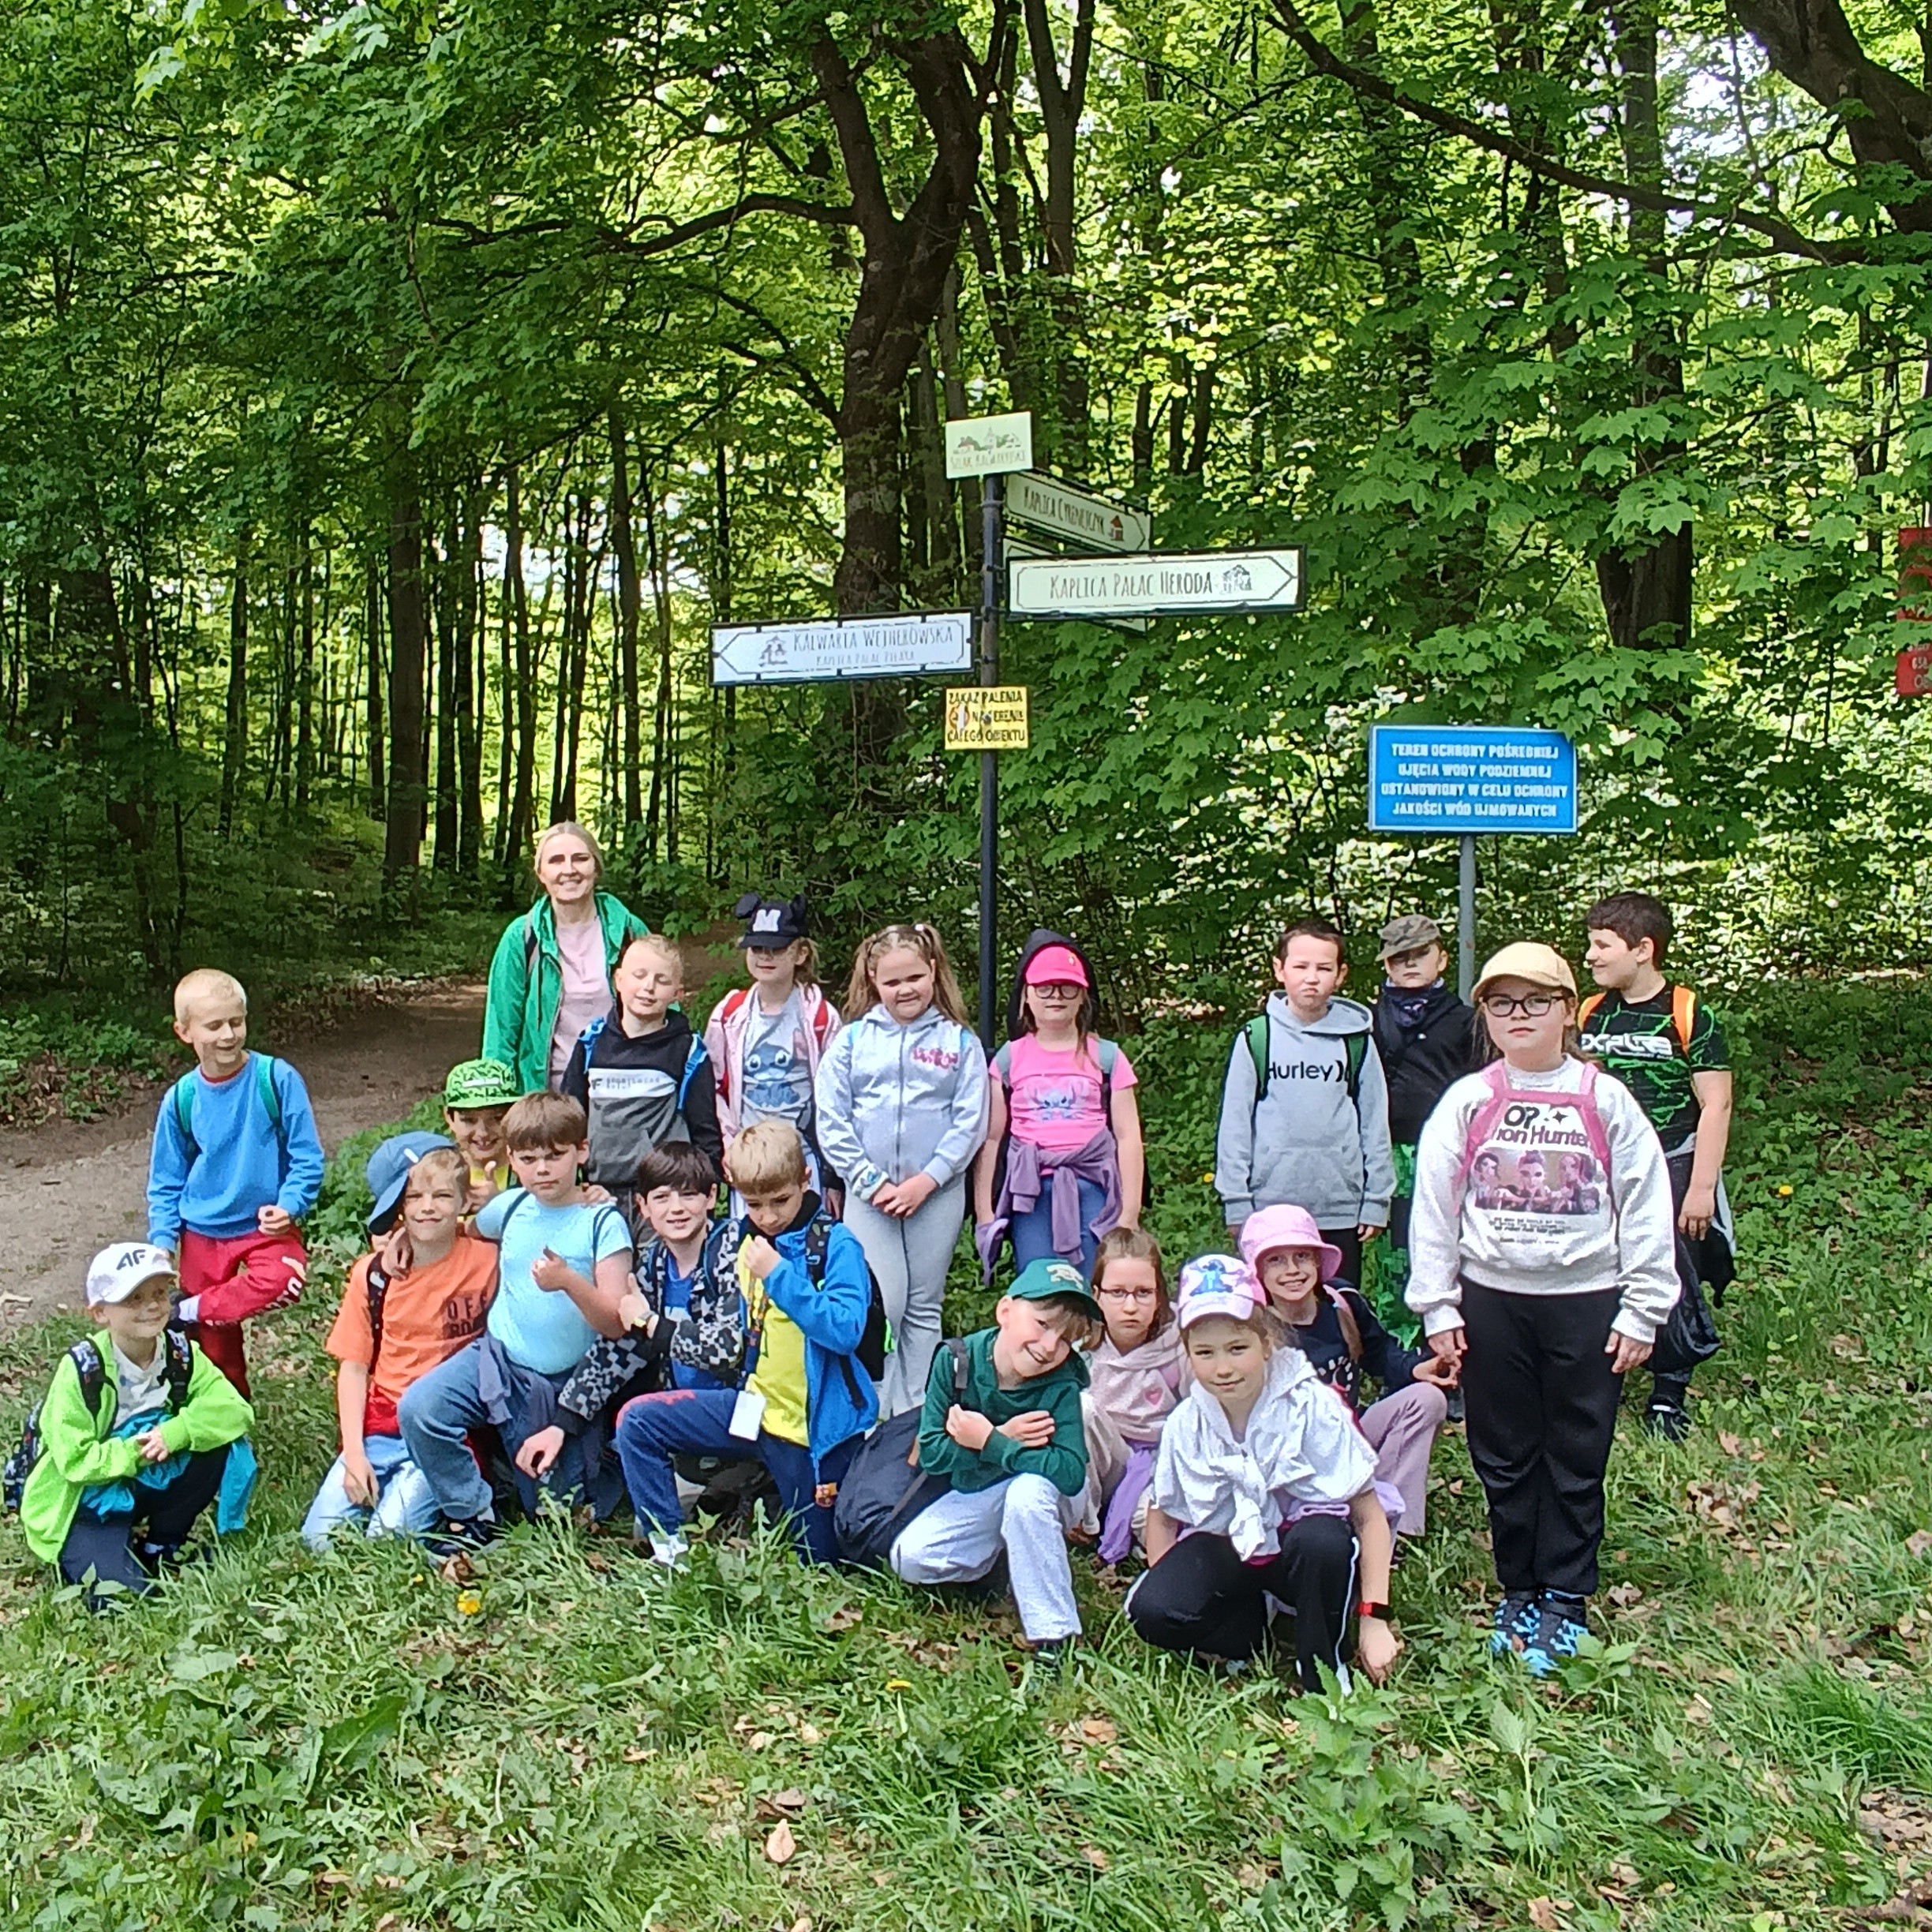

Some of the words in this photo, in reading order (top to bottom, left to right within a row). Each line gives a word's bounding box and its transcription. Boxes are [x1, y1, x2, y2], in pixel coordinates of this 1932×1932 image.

[1050, 575, 1106, 600] KAPLICA
[1114, 573, 1154, 597] PAŁAC
[1160, 571, 1213, 595] HERODA
[793, 631, 858, 653] KALWARIA
[863, 626, 953, 648] WEJHEROWSKA
[949, 691, 979, 704] ZAKAZ
[981, 690, 1023, 704] PALENIA
[1391, 743, 1428, 758] TEREN
[1431, 743, 1486, 758] OCHRONY
[1489, 742, 1559, 759] POŚREDNIEJ
[1398, 763, 1440, 778] UJĘCIA
[1442, 764, 1477, 777] WODY
[1479, 765, 1552, 779] PODZIEMNEJ
[1381, 783, 1466, 796] USTANOWIONY
[1467, 784, 1481, 796] W
[1481, 784, 1511, 797] CELU
[1514, 784, 1568, 799] OCHRONY
[1392, 799, 1443, 815] JAKOŚCI
[1444, 800, 1472, 815] WÓD
[1474, 803, 1557, 818] UJMOWANYCH
[752, 908, 781, 933] M
[1530, 1125, 1589, 1148] Hunte
